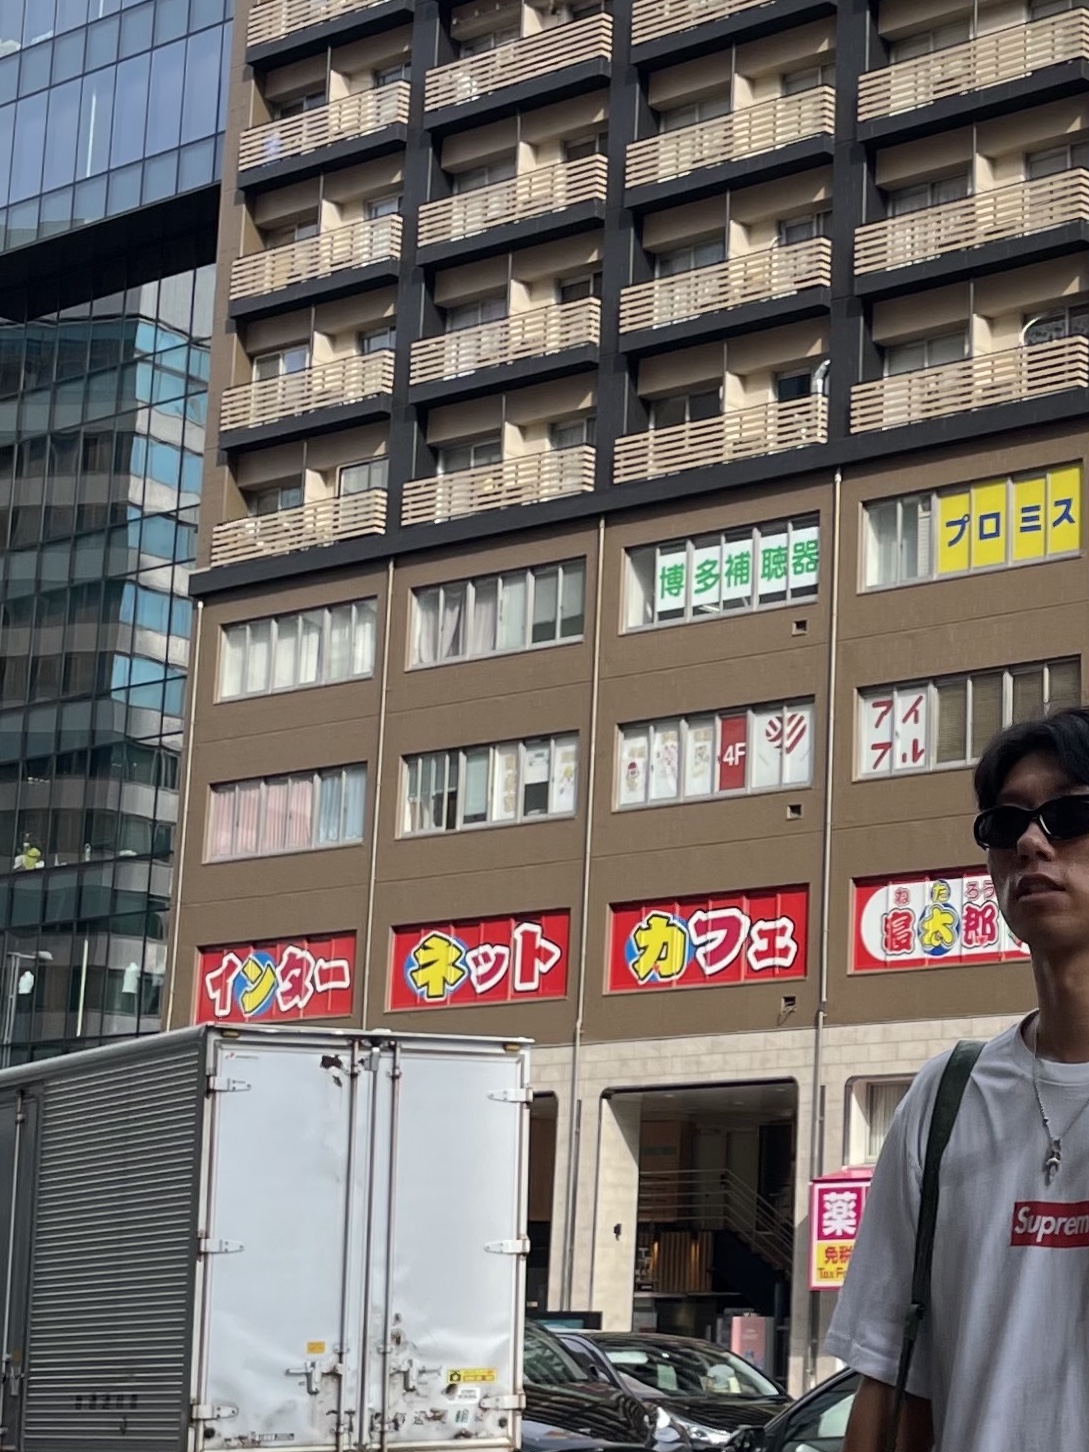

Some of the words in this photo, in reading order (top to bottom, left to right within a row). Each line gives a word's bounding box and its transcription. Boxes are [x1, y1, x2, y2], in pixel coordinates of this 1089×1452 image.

[945, 498, 1076, 547] プロミス
[660, 539, 819, 599] 博多補聴器
[871, 696, 922, 729] アイ
[722, 743, 746, 766] 4F
[871, 739, 925, 770] フル
[205, 946, 351, 1017] インター
[412, 922, 561, 1000] ネット
[633, 907, 799, 984] カフェ
[822, 1191, 857, 1236] 薬
[818, 1267, 834, 1279] Tax
